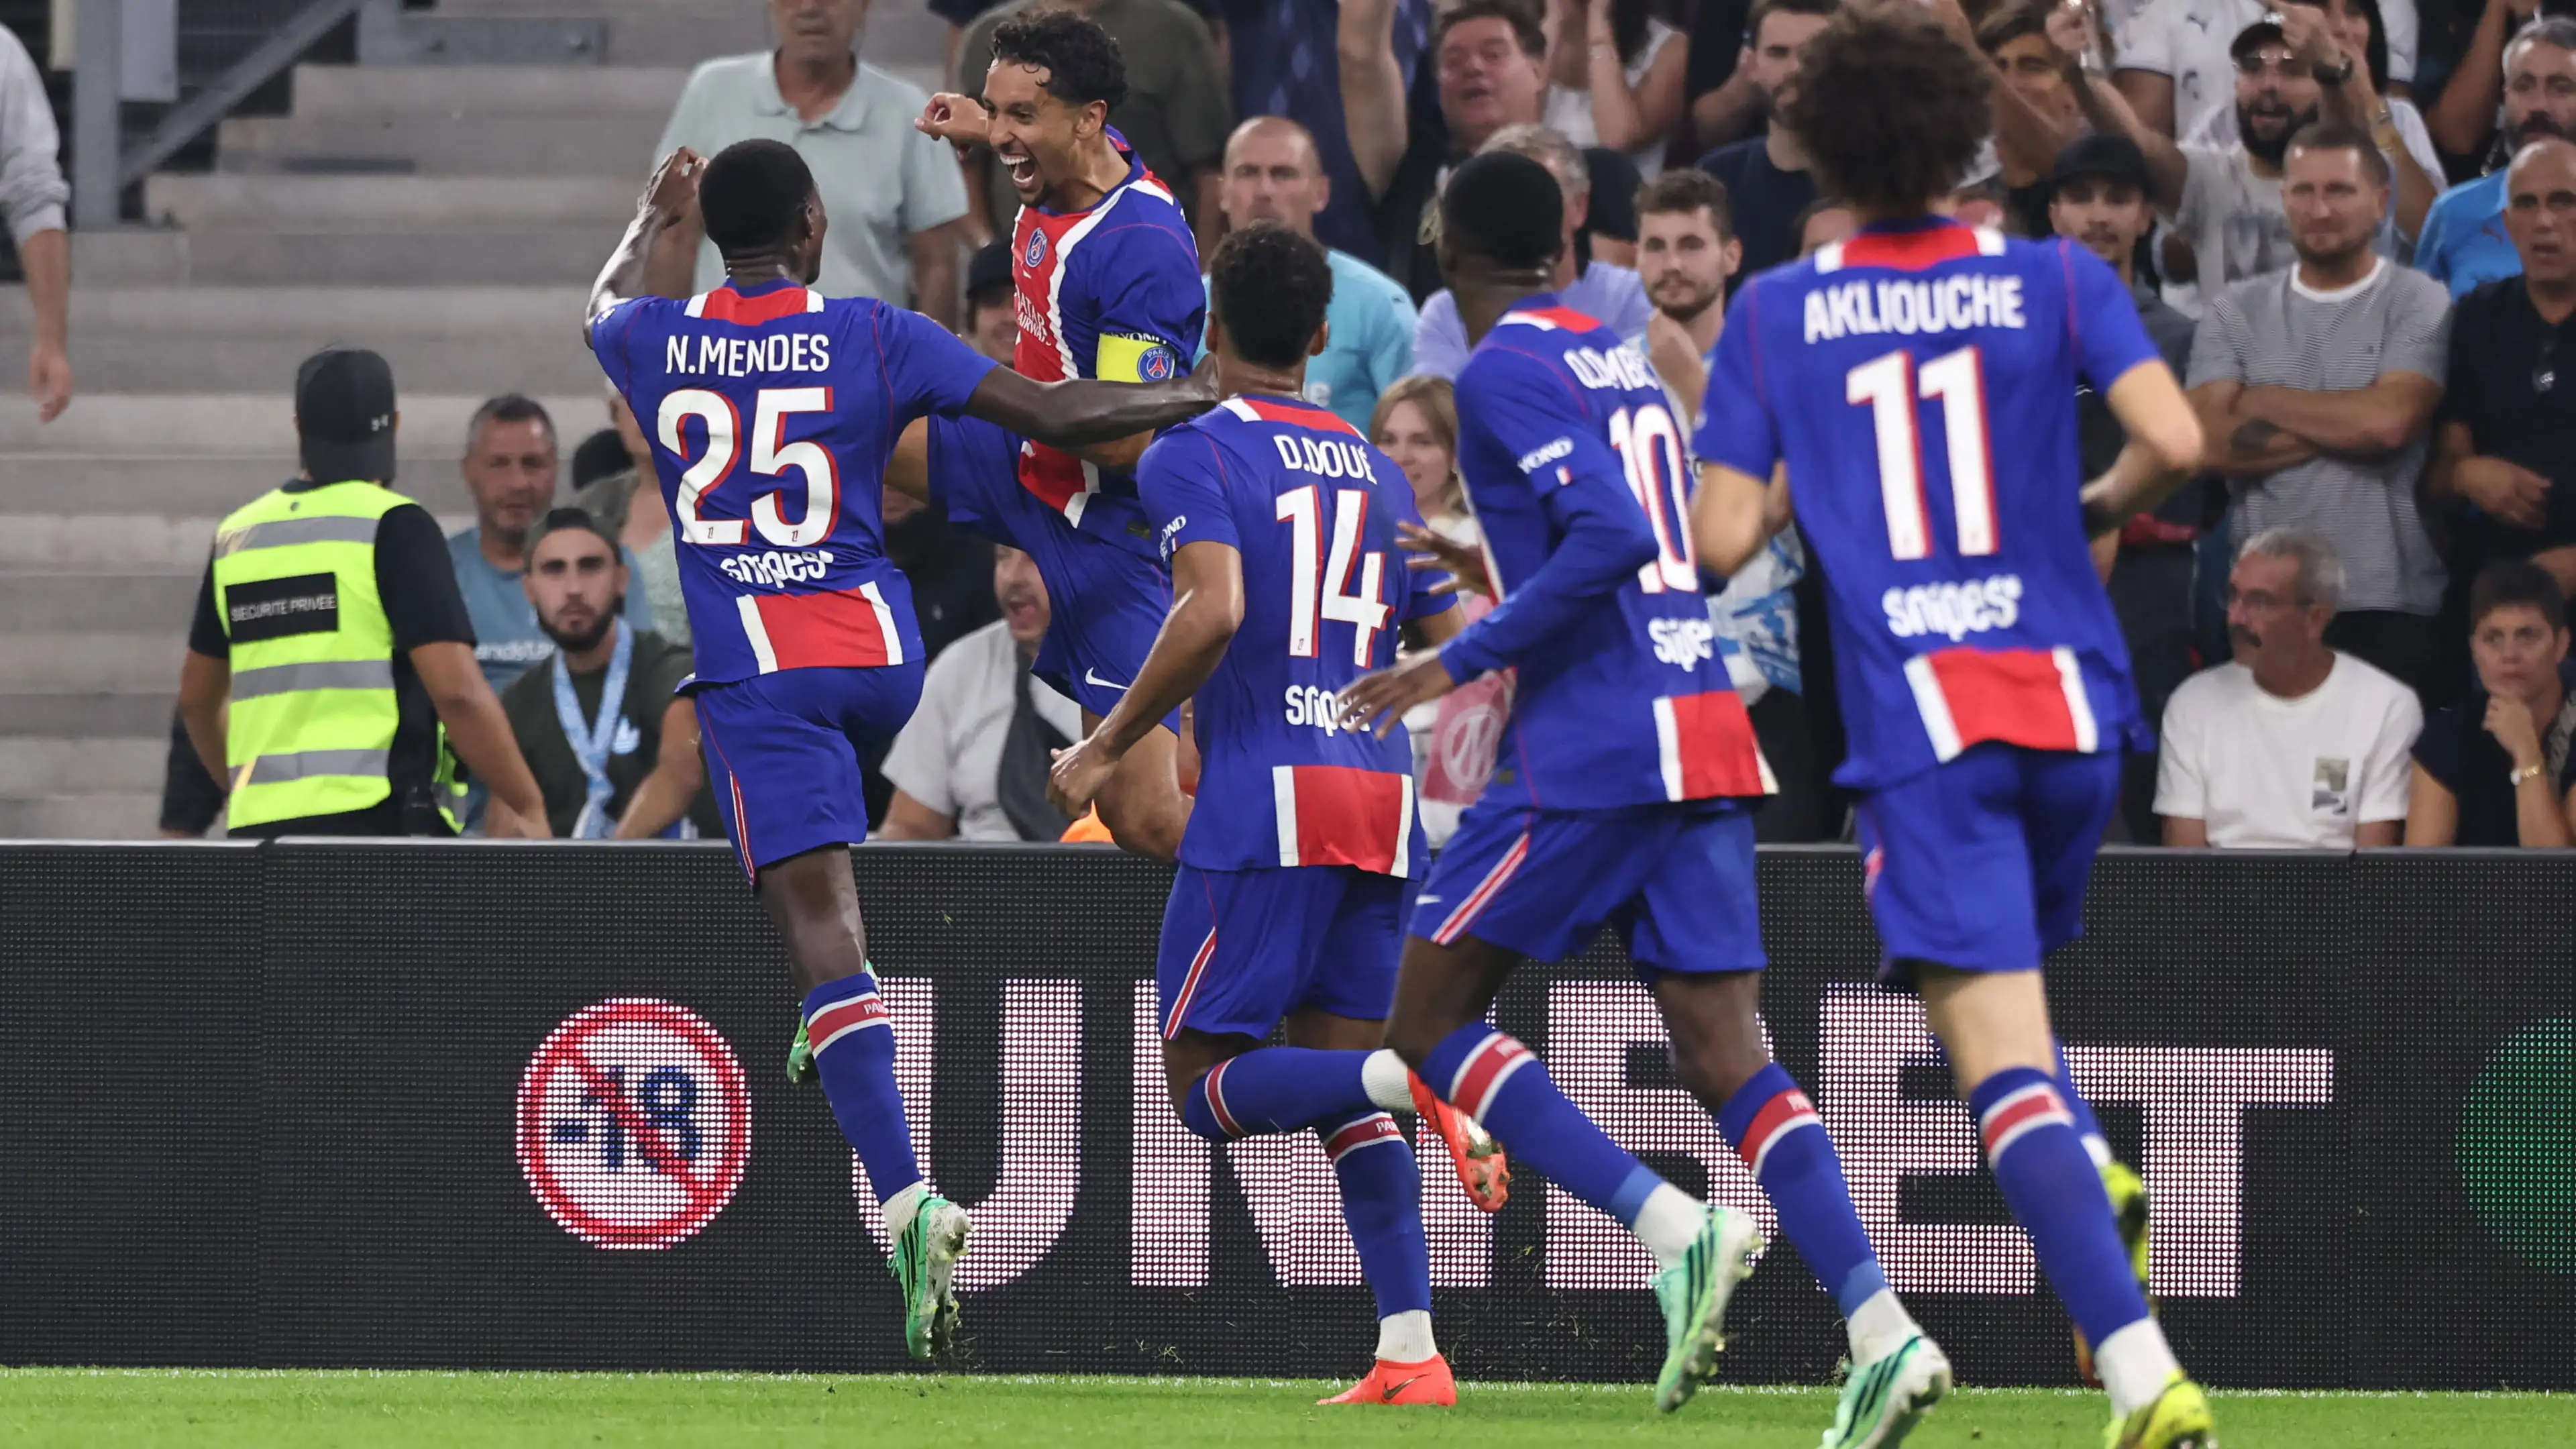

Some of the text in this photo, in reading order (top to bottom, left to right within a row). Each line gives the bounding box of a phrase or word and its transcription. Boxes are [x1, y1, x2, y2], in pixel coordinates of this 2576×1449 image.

[665, 333, 830, 377] N.MENDES
[1804, 274, 2027, 344] AKLIOUCHE
[657, 386, 840, 547] 25
[1609, 404, 1698, 594] 10
[1846, 345, 2000, 561] 11
[1276, 484, 1395, 668] 14
